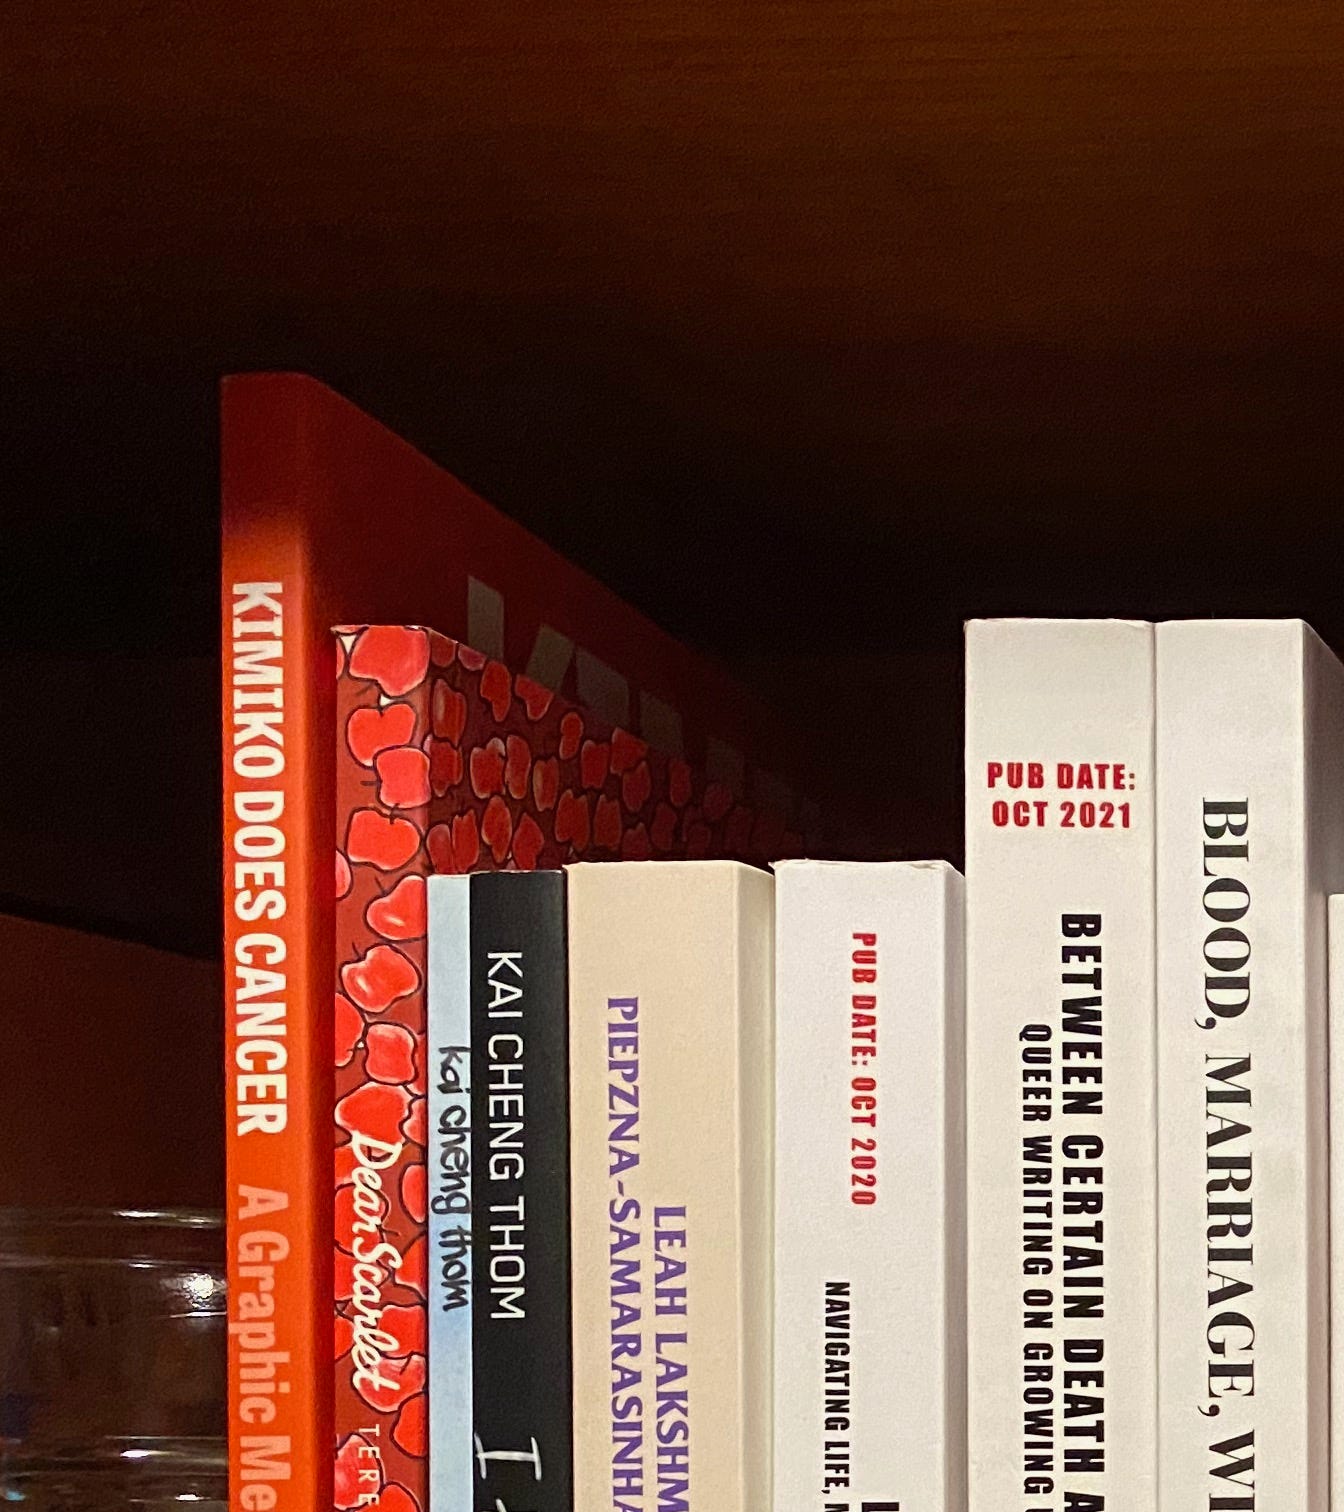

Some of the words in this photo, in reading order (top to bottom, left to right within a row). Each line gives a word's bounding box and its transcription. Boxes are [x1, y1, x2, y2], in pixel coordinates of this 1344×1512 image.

[232, 582, 287, 779] KIMIKO
[987, 762, 1044, 788] PUB
[1057, 763, 1135, 790] DATE:
[992, 800, 1048, 827] OCT
[1060, 801, 1130, 828] 2021
[232, 792, 287, 918] DOES
[1196, 798, 1250, 1031] BLOOD,
[485, 952, 524, 1019] KAI
[851, 933, 877, 985] PUB
[1062, 913, 1103, 1116] BETWEEN
[232, 933, 287, 1135] CANCER
[851, 996, 877, 1069] DATE:
[485, 1033, 524, 1179] CHENG
[851, 1076, 877, 1127] OCT
[350, 1131, 401, 1232] Dear
[851, 1140, 877, 1205] 2020
[1063, 1135, 1104, 1323] CERTAIN
[485, 1195, 524, 1319] THOM
[654, 1205, 689, 1315] LEAH
[1197, 1055, 1255, 1418] MARRIAGE,
[350, 1239, 402, 1393] Scarlet
[822, 1281, 849, 1430] NAVIGATING
[475, 1435, 546, 1477] I
[822, 1439, 849, 1495] LIFE,
[1063, 1339, 1104, 1474] DEATH
